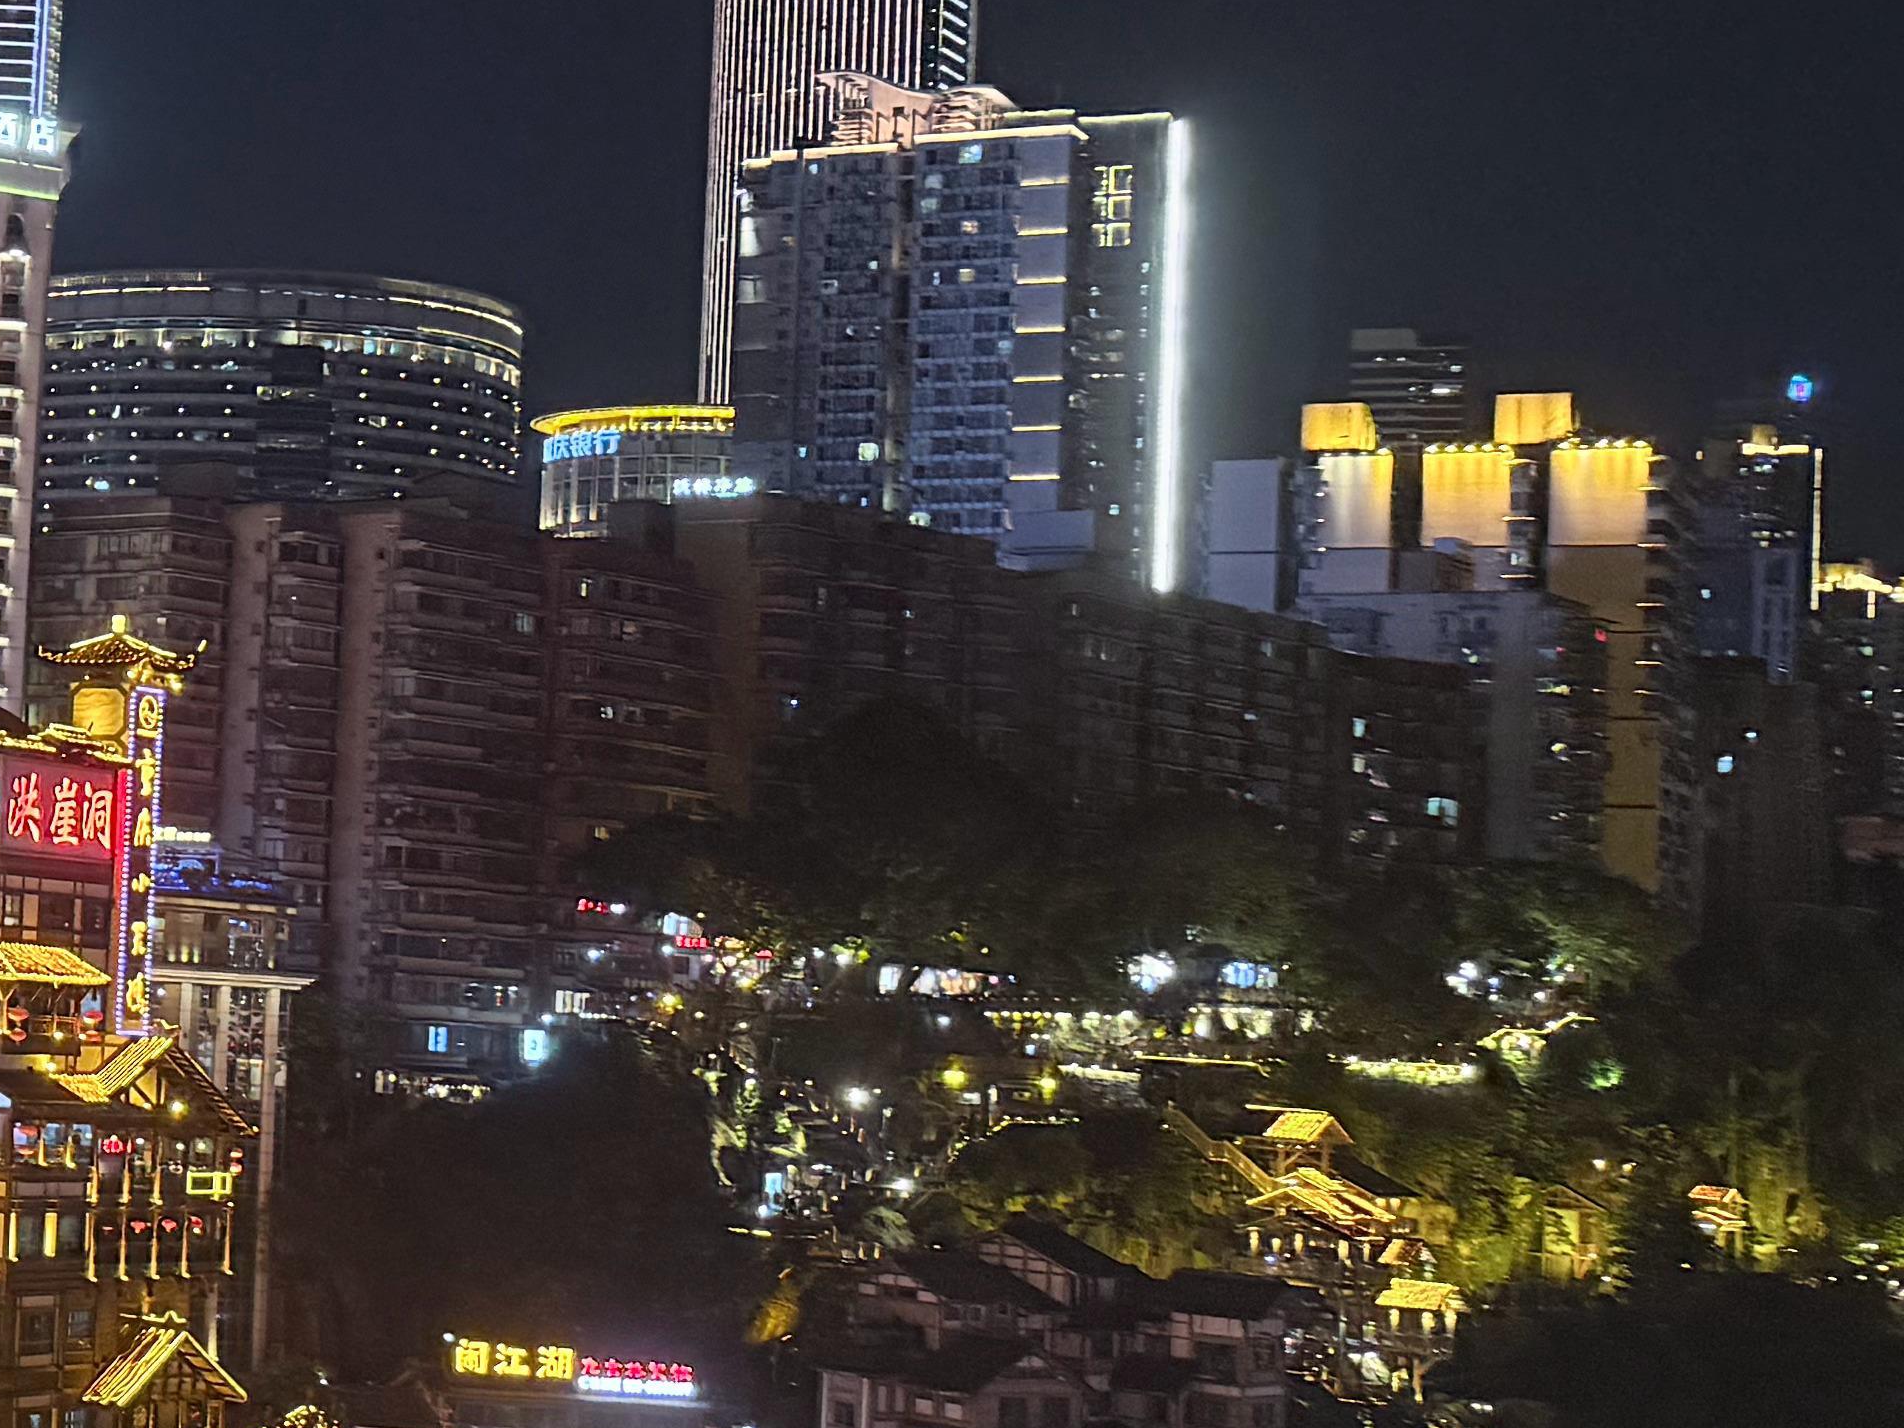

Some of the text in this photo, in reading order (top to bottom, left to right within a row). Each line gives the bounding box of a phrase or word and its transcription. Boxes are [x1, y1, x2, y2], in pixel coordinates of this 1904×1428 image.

[7, 772, 113, 850] 洪崖洞
[455, 1338, 575, 1380] 闹江湖
